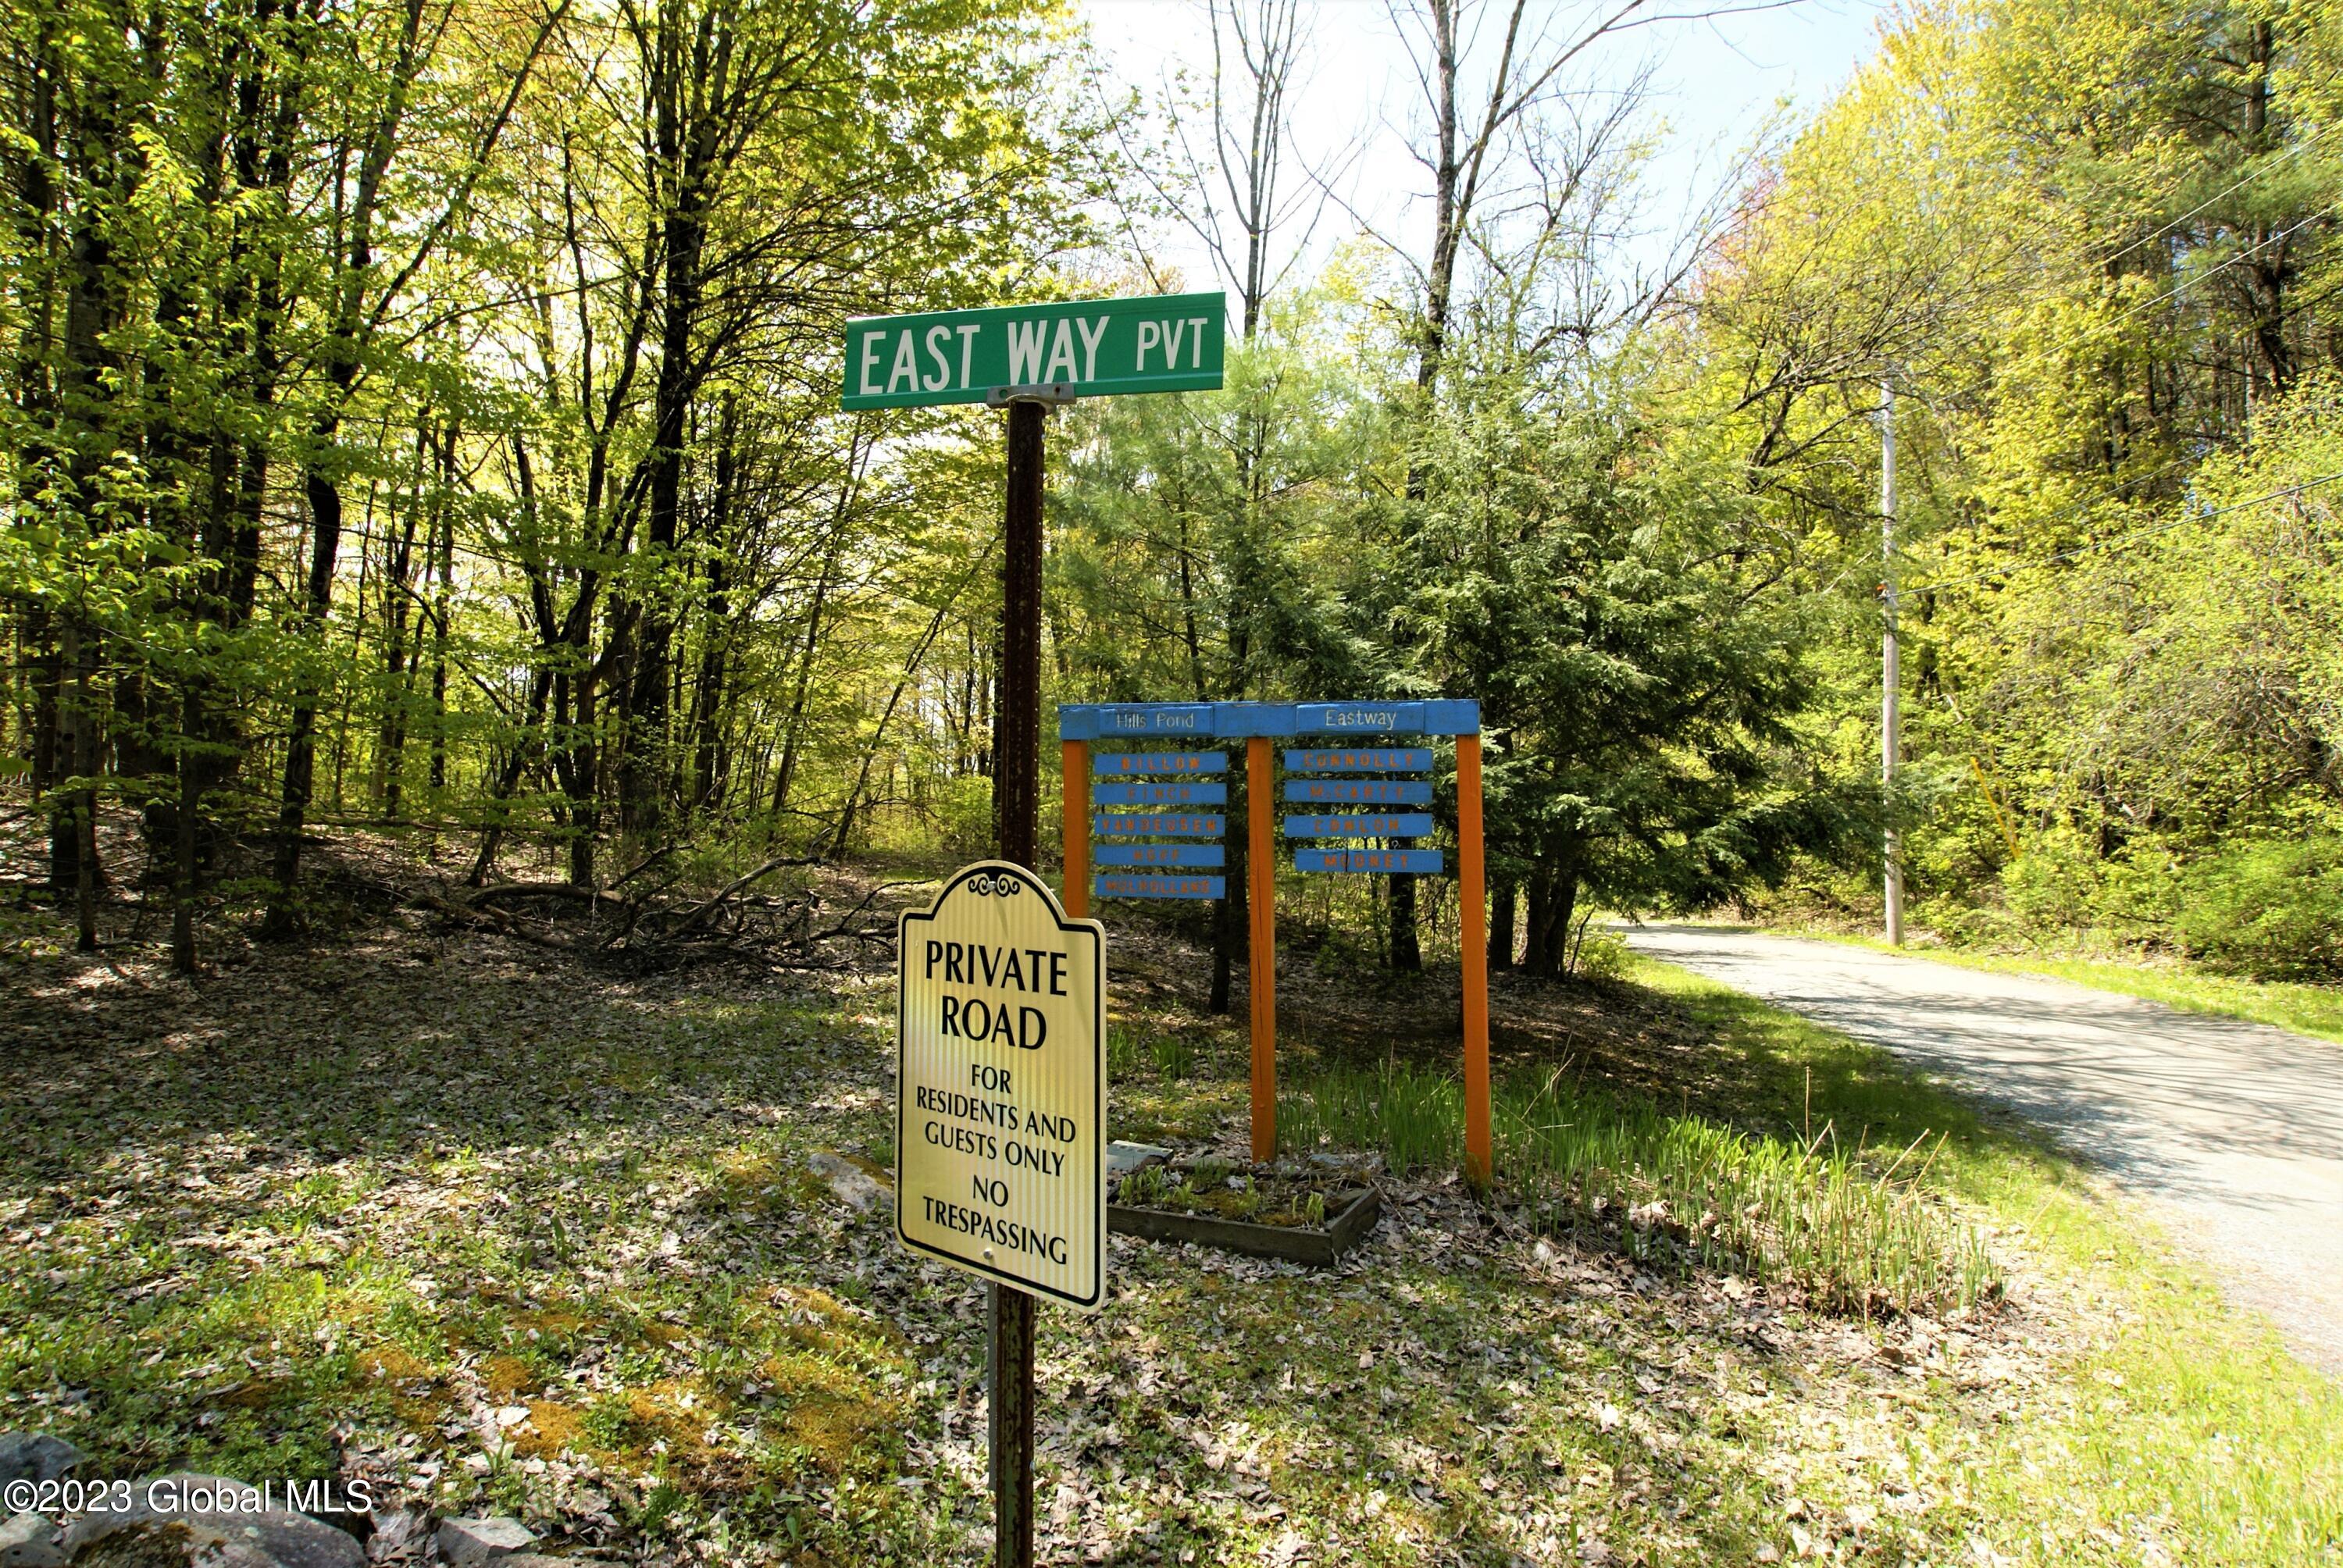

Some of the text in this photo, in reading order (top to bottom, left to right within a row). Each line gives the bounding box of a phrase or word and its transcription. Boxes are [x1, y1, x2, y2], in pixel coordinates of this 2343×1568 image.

[860, 315, 1208, 395] EAST WAY PVT
[1117, 712, 1194, 729] Hills Pond
[1326, 709, 1396, 730] Eastway
[1303, 753, 1413, 768] CONNOLLY
[1127, 788, 1190, 800] FINCH
[1324, 854, 1409, 869] MOONEY
[925, 940, 1068, 997] PRIVATE
[941, 995, 1047, 1050] ROAD
[971, 1064, 1012, 1094] FOR
[916, 1085, 1077, 1144] RESIDENTS AND
[925, 1121, 1065, 1178] GUESTS ONLY
[972, 1174, 1009, 1208] NO
[922, 1196, 1068, 1266] TRESPASSING
